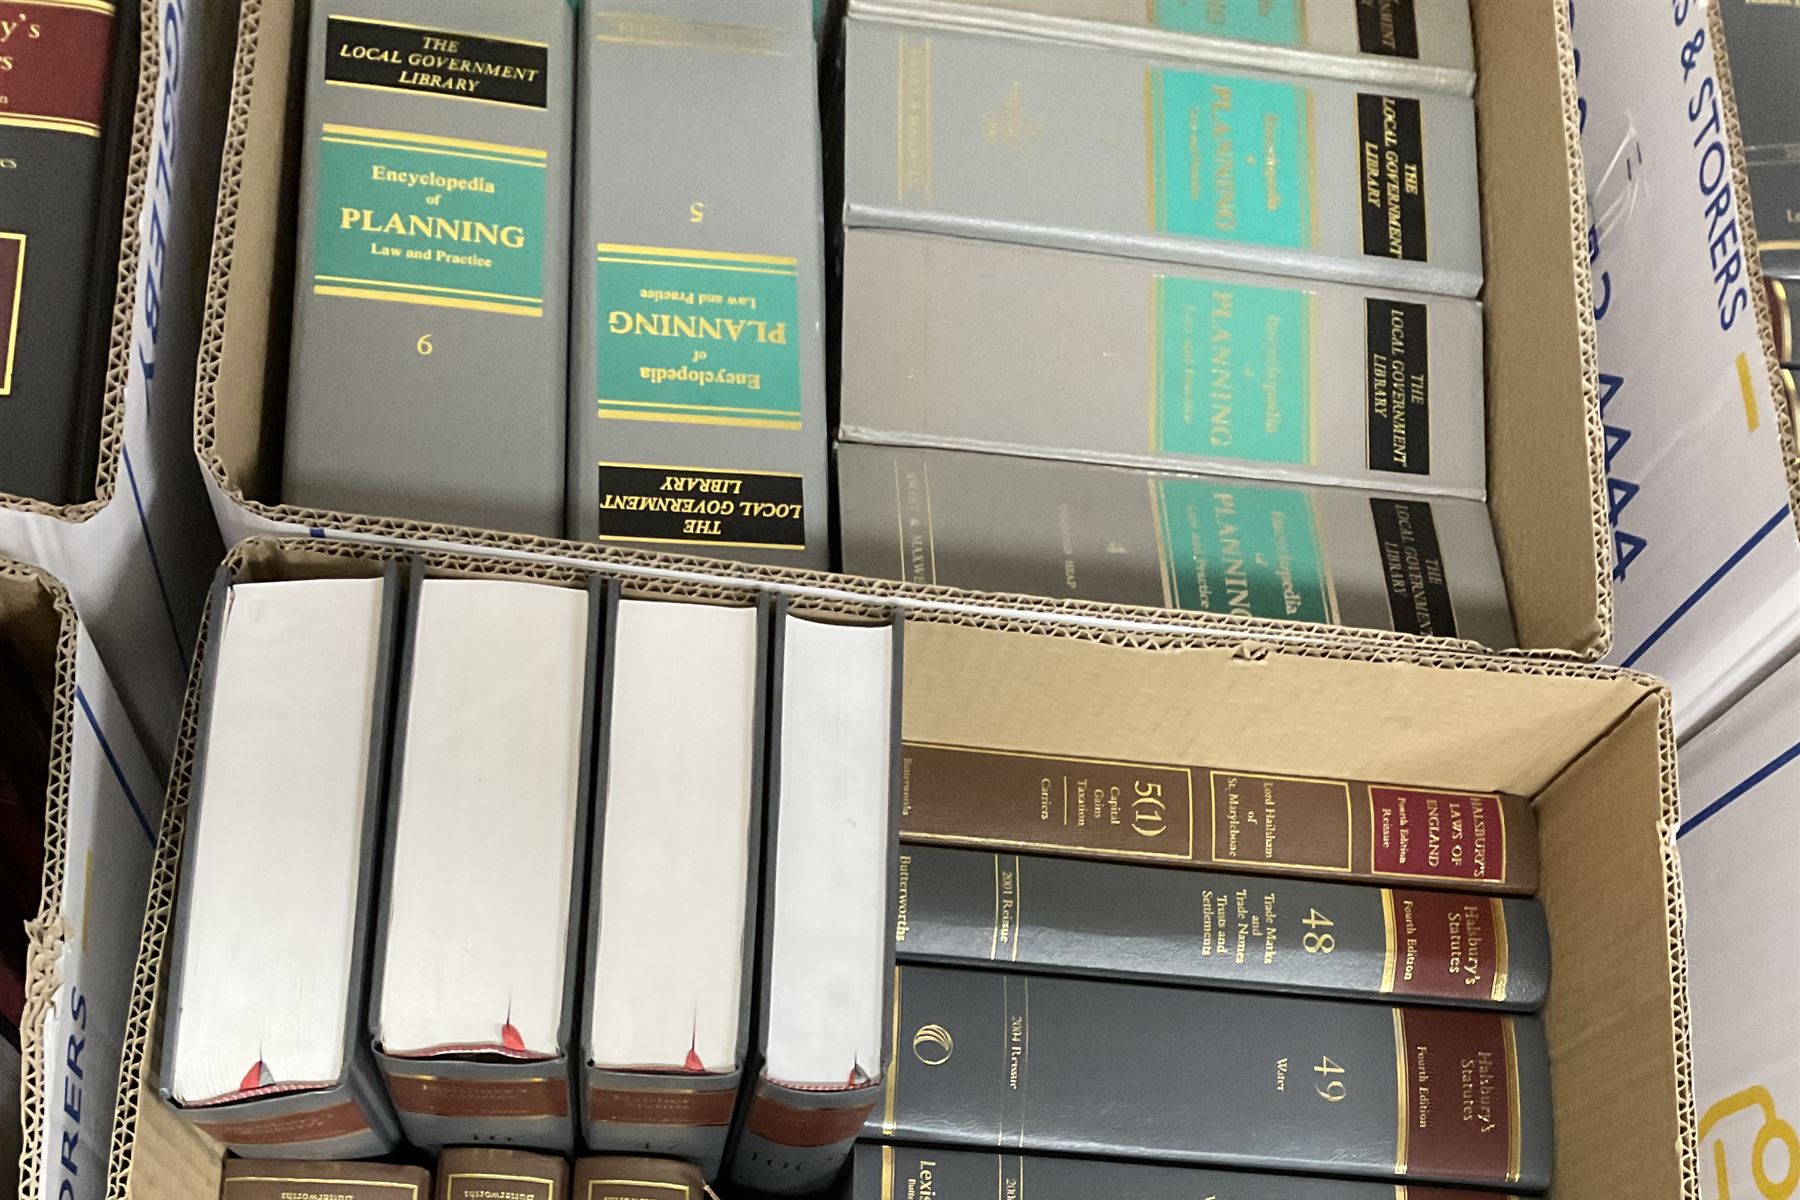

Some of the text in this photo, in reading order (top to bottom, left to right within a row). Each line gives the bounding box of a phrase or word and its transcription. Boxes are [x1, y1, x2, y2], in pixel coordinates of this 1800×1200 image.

[339, 45, 538, 83] LOCAL GOVERNMENT
[423, 36, 458, 53] THE
[1680, 28, 1704, 84] &
[399, 71, 480, 93] LIBRARY
[372, 165, 495, 193] Encyclopedia
[1365, 141, 1380, 208] LIBRARY
[1382, 96, 1402, 258] LOCAL GOVERNMENT
[1405, 163, 1418, 195] THE
[426, 194, 441, 205] of
[690, 202, 704, 222] 5
[1688, 77, 1747, 331] STORERS
[339, 208, 524, 248] PLANNING
[371, 243, 492, 267] Law and Practice
[640, 289, 756, 309] Law and Practice
[417, 334, 432, 355] 6
[608, 311, 786, 344] PLANNING
[640, 366, 760, 389] Encyclopedia
[692, 351, 707, 362] of
[1210, 292, 1232, 446] PLANNING
[1374, 354, 1386, 417] LIBRARY
[1391, 309, 1406, 467] LOCAL GOVERNMENT
[1411, 374, 1424, 405] THE
[600, 495, 801, 518] LOCAL GOVERNMENT
[661, 476, 742, 494] LIBRARY
[683, 520, 721, 535] THE
[1385, 542, 1405, 594] LIBRARY
[1425, 559, 1442, 585] THE
[1041, 778, 1051, 820] Carriers
[1078, 779, 1087, 826] Taxation
[1094, 789, 1103, 818] Gains
[1111, 786, 1120, 825] Capital
[1131, 780, 1166, 836] 5(1)
[1247, 812, 1257, 825] of
[1264, 782, 1276, 858] Lord Hailsham
[1382, 808, 1392, 848] Reissue
[1427, 800, 1439, 867] ENGLAND
[1449, 803, 1463, 866] LAWS OF
[896, 855, 911, 941] Butterworths
[1001, 871, 1013, 943] 2001 Reissue
[1202, 891, 1212, 956] Settlements
[1217, 895, 1227, 954] Trusts and
[1236, 889, 1247, 965] Trade Names
[1252, 915, 1262, 936] and
[1264, 893, 1277, 965] Trade Marks
[1302, 908, 1334, 954] 48
[1404, 900, 1418, 981] Fourth Edition
[1448, 914, 1461, 973] Statutes
[1464, 906, 1477, 985] Halsbury's
[1009, 1016, 1022, 1090] 2004 Reissue
[1276, 1058, 1288, 1093] Water
[1314, 1056, 1347, 1102] 49
[1417, 1047, 1429, 1128] Fourth Edition
[1461, 1059, 1472, 1121] Statutes
[1478, 1051, 1494, 1133] Halsbury's
